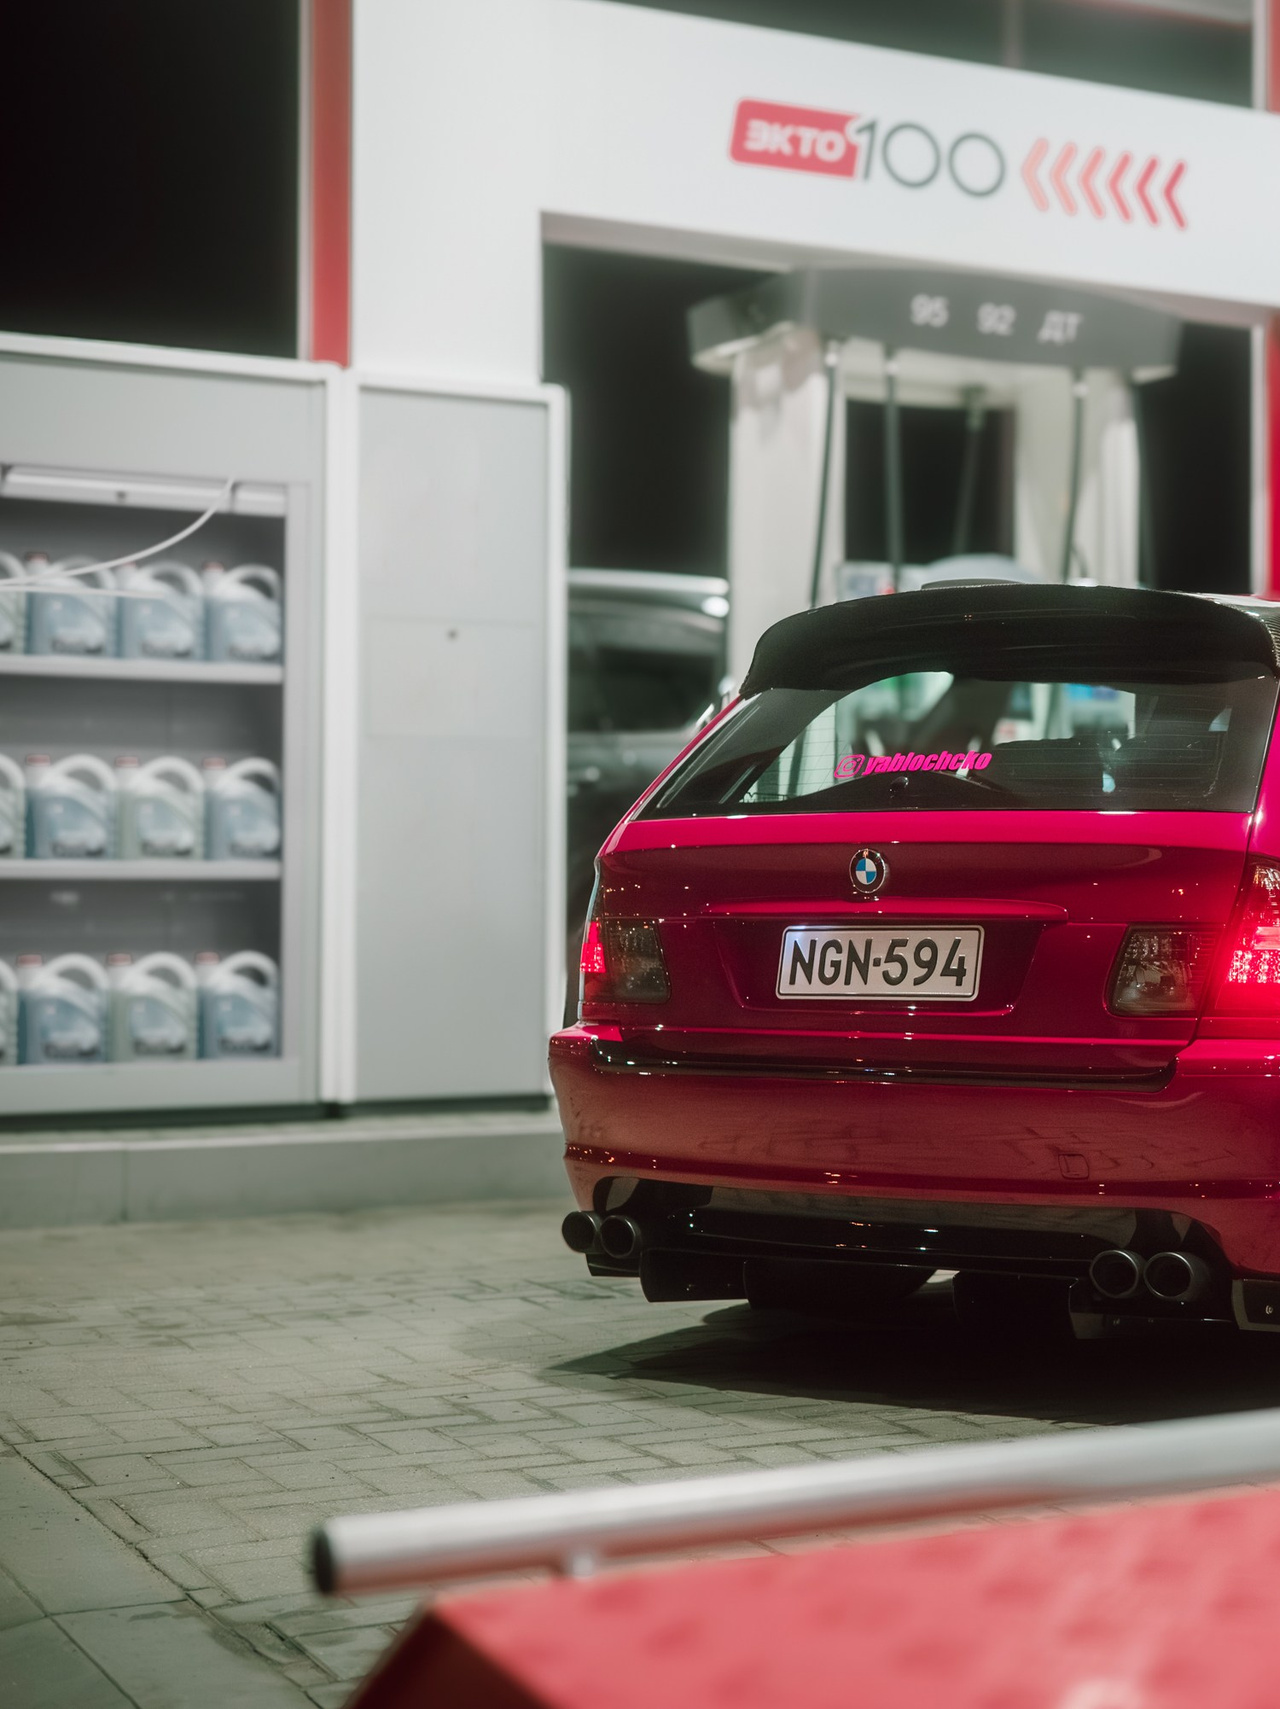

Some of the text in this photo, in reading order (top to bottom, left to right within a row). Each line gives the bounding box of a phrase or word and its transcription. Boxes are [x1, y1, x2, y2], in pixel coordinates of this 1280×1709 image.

[743, 118, 1006, 197] ЭКТО 100
[911, 293, 949, 328] 95
[977, 302, 1017, 337] 92
[789, 938, 967, 987] NGN-594
